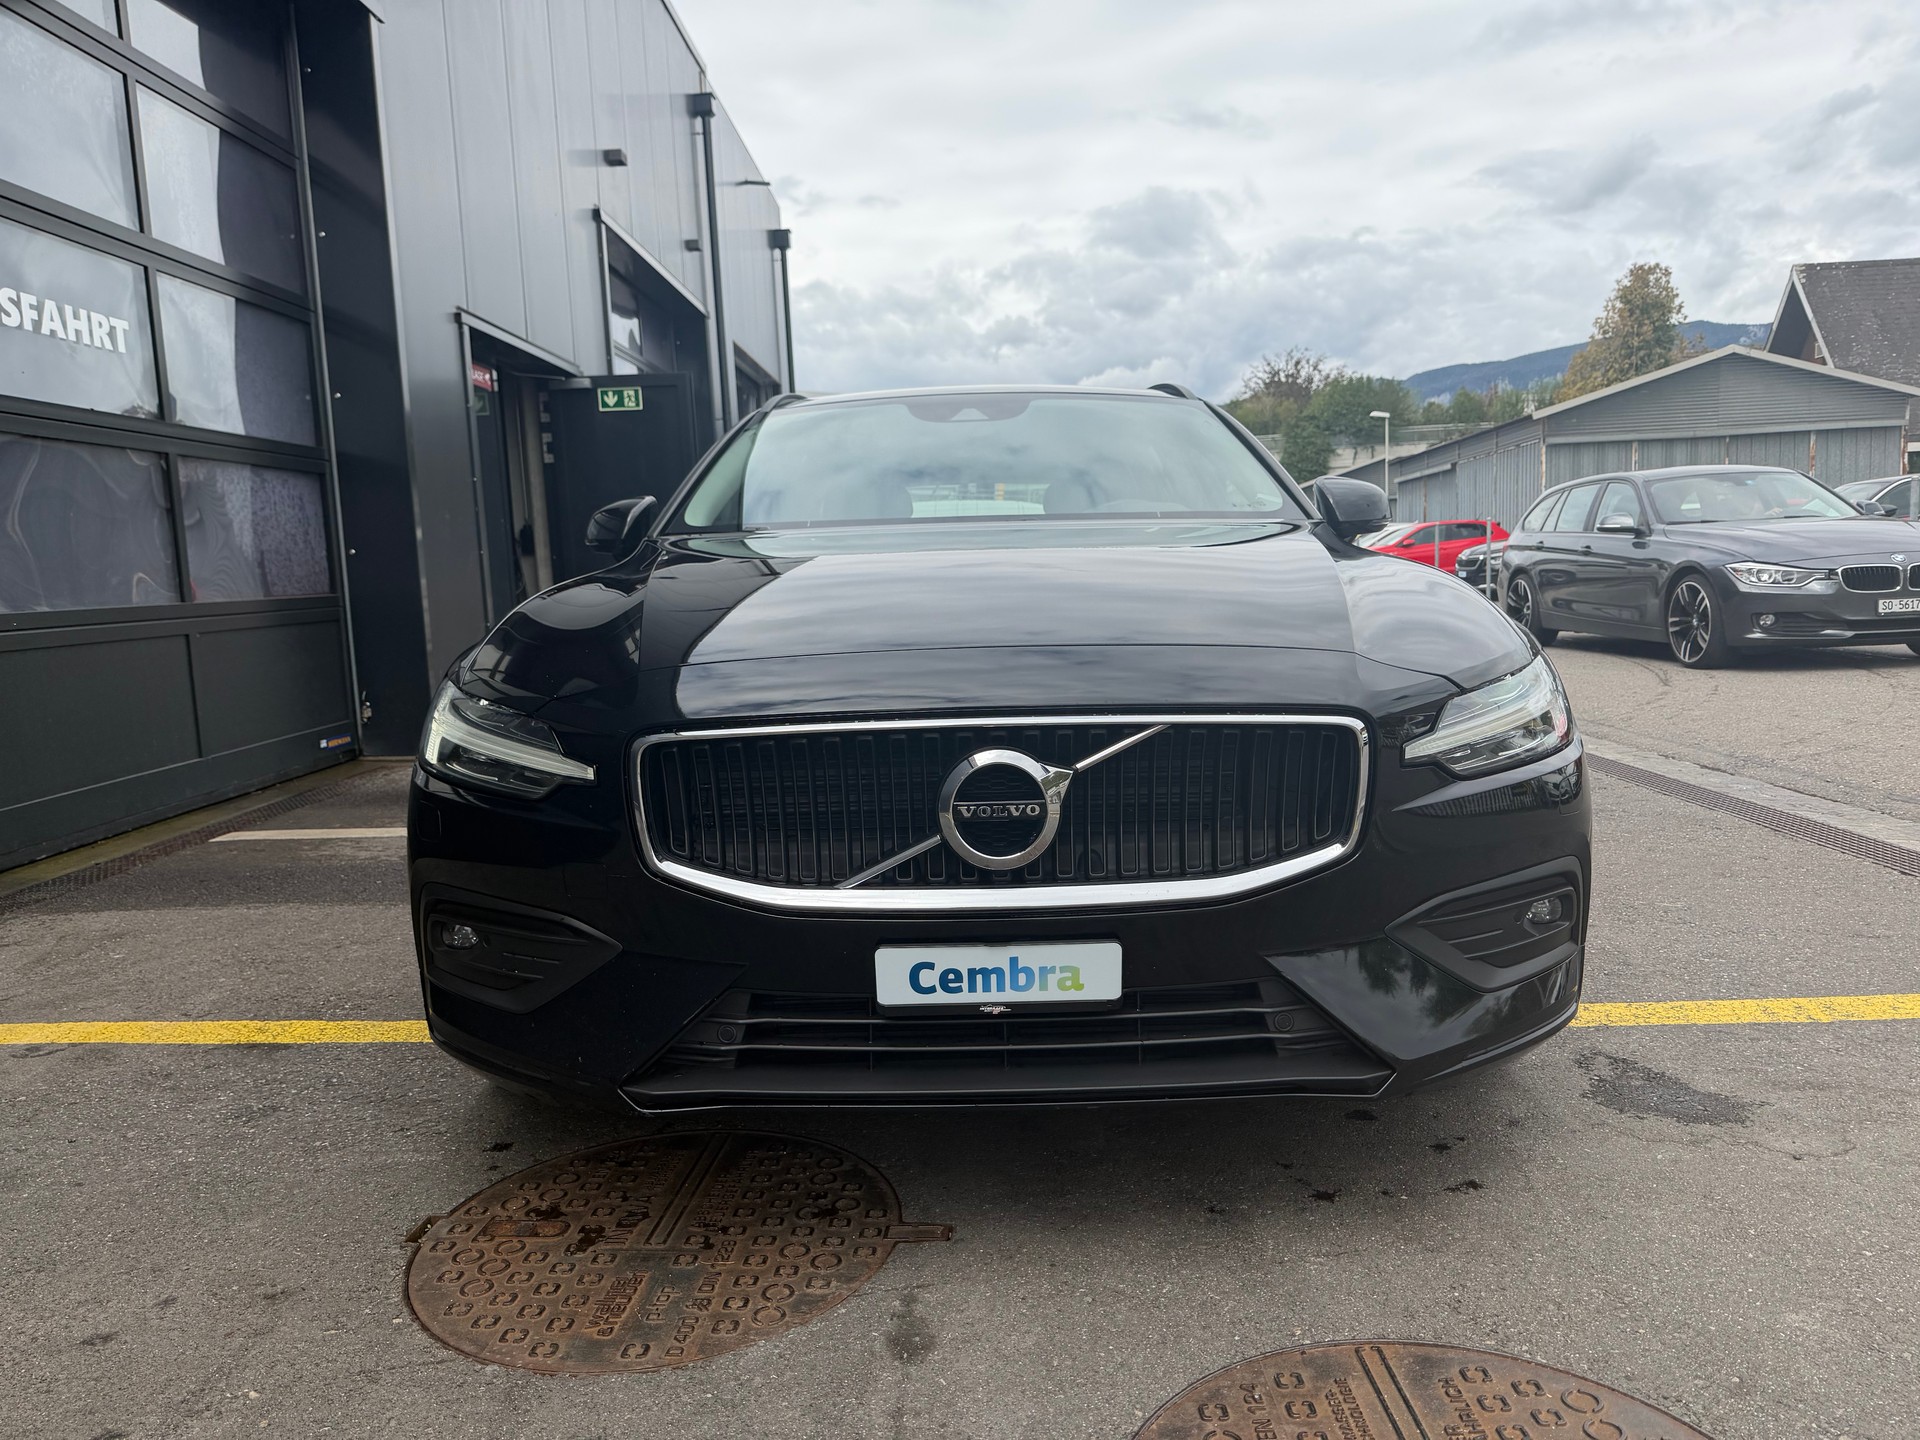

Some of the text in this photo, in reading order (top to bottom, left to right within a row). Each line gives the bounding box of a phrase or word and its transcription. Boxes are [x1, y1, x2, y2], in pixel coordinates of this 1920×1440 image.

[0, 287, 129, 354] SFAHRT
[957, 804, 1041, 817] VOLVO
[908, 956, 1085, 995] Cembra
[1239, 1383, 1266, 1415] 124
